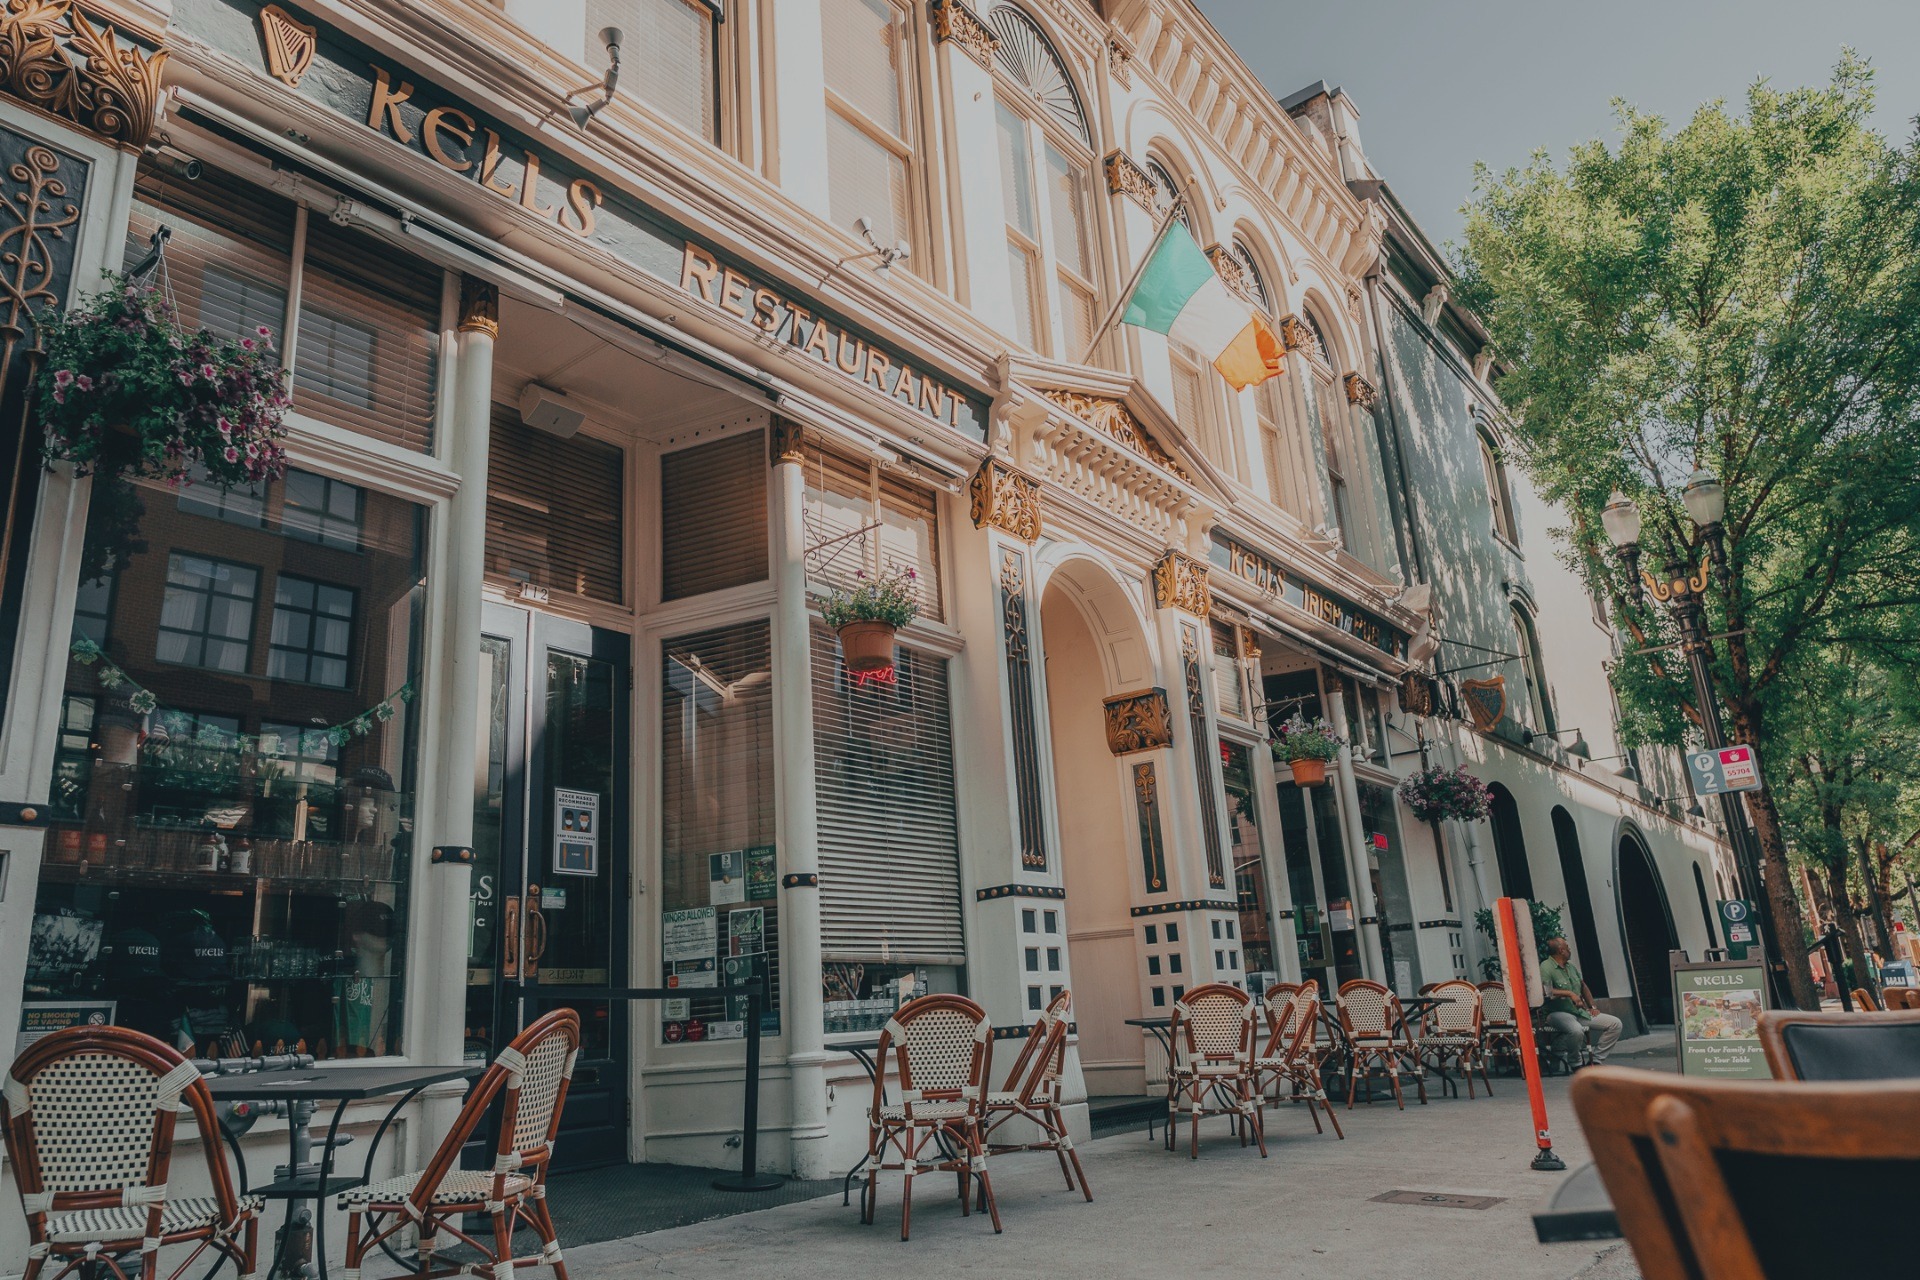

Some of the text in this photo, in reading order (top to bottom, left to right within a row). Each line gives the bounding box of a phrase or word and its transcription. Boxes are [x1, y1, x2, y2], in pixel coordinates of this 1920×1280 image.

[369, 63, 603, 238] KELLS
[680, 240, 966, 427] RESTAURANT
[524, 583, 548, 601] 112
[1229, 541, 1287, 599] KELLS
[1303, 583, 1342, 629] IRISH
[1700, 756, 1710, 769] P
[1702, 772, 1718, 788] 2
[1727, 767, 1751, 777] 55704
[663, 907, 715, 923] MINORS ALLOWED
[1730, 904, 1741, 918] P
[1703, 974, 1744, 986] KELLS
[1687, 1046, 1706, 1054] From
[1707, 1046, 1721, 1054] Our
[1722, 1046, 1746, 1055] Family
[1713, 1056, 1730, 1064] Your
[1731, 1056, 1751, 1064] Table
